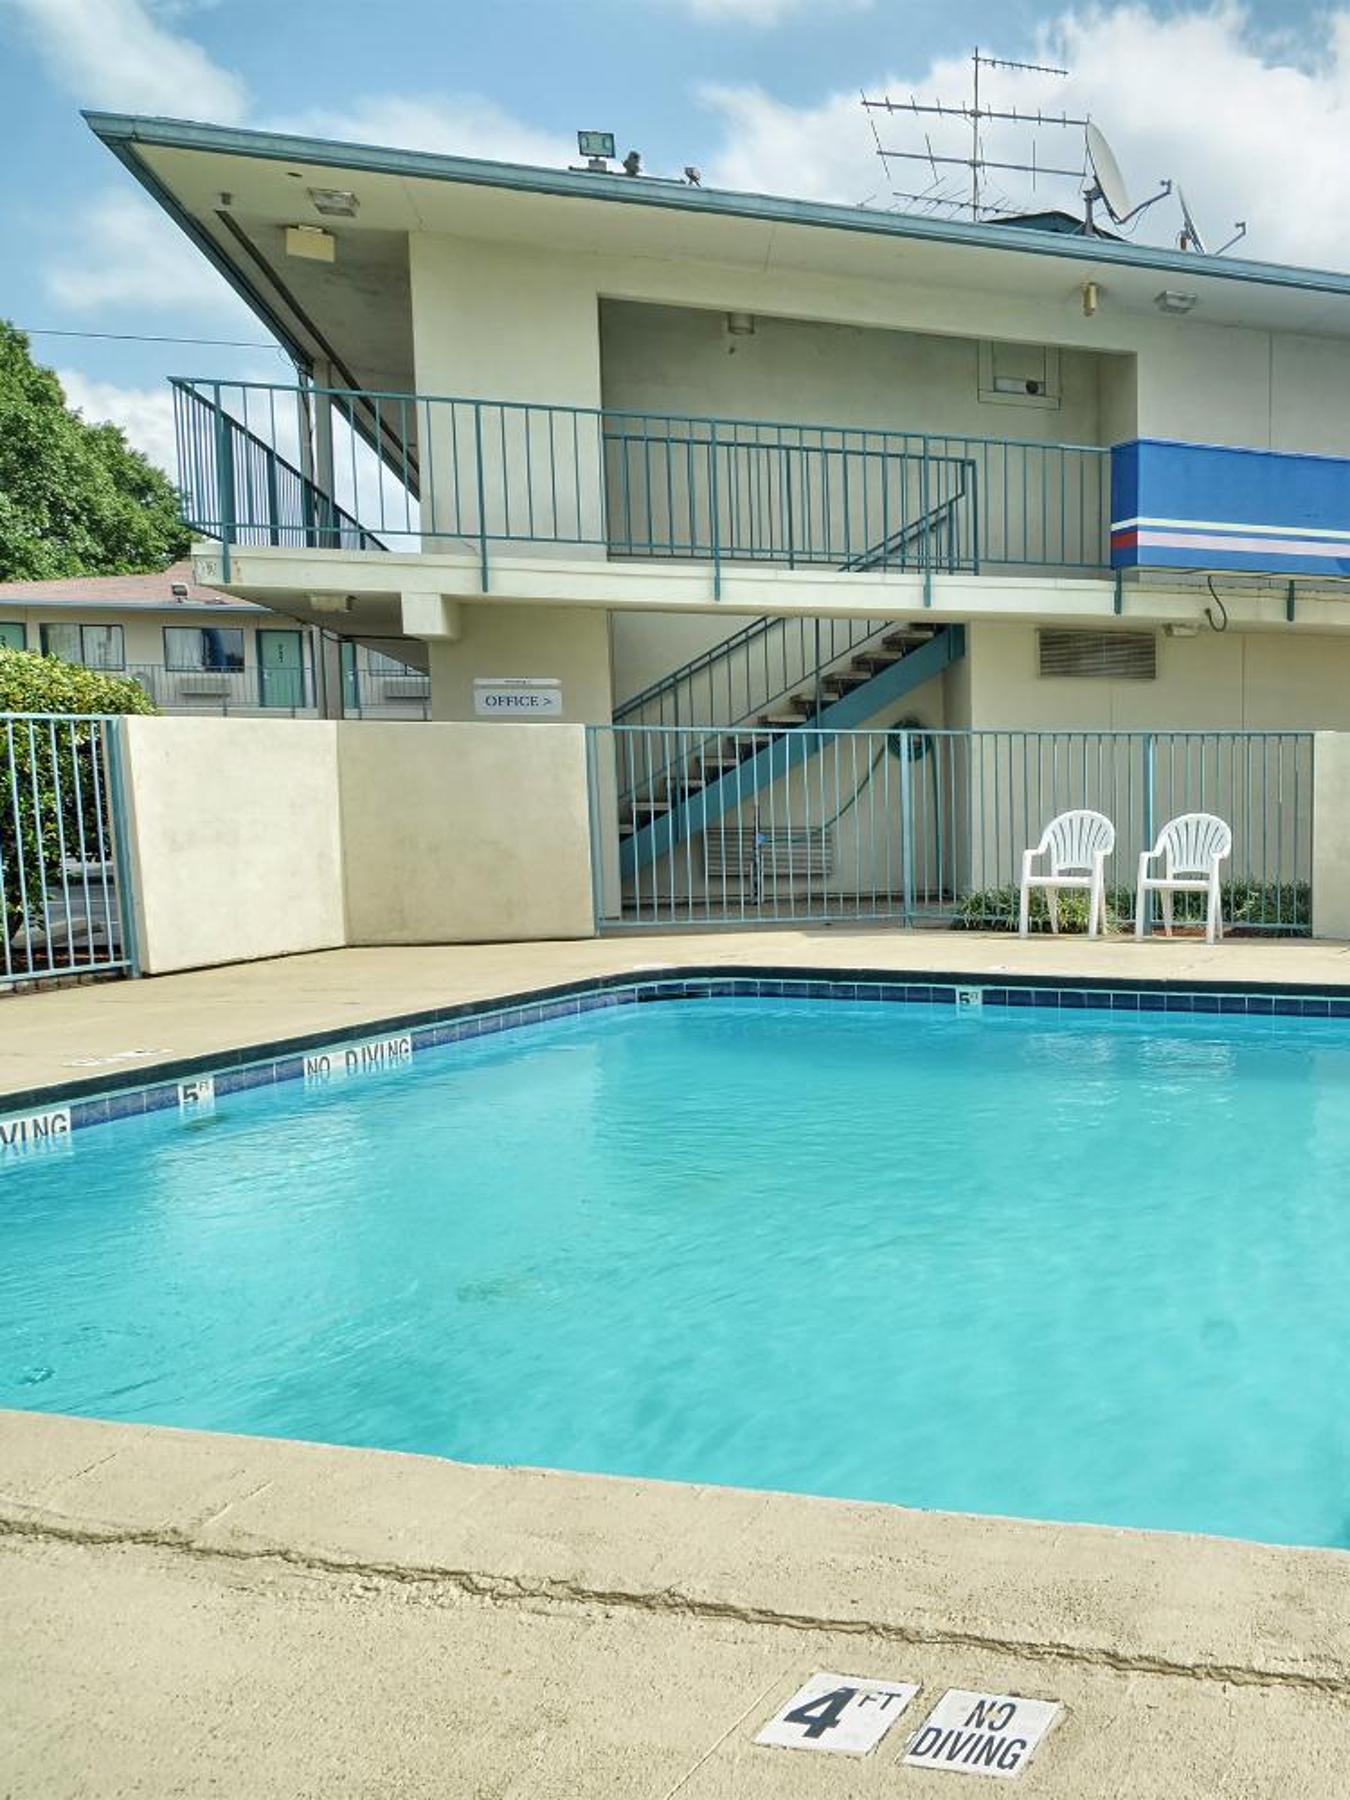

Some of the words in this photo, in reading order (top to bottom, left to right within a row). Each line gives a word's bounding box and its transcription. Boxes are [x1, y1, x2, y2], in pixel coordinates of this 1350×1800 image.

[485, 696, 540, 707] OFFICE
[307, 1056, 331, 1076] NO
[345, 1038, 410, 1066] DIVING
[0, 1113, 68, 1145] VING
[964, 1699, 1017, 1732] NO
[908, 1727, 1028, 1770] DIVING
